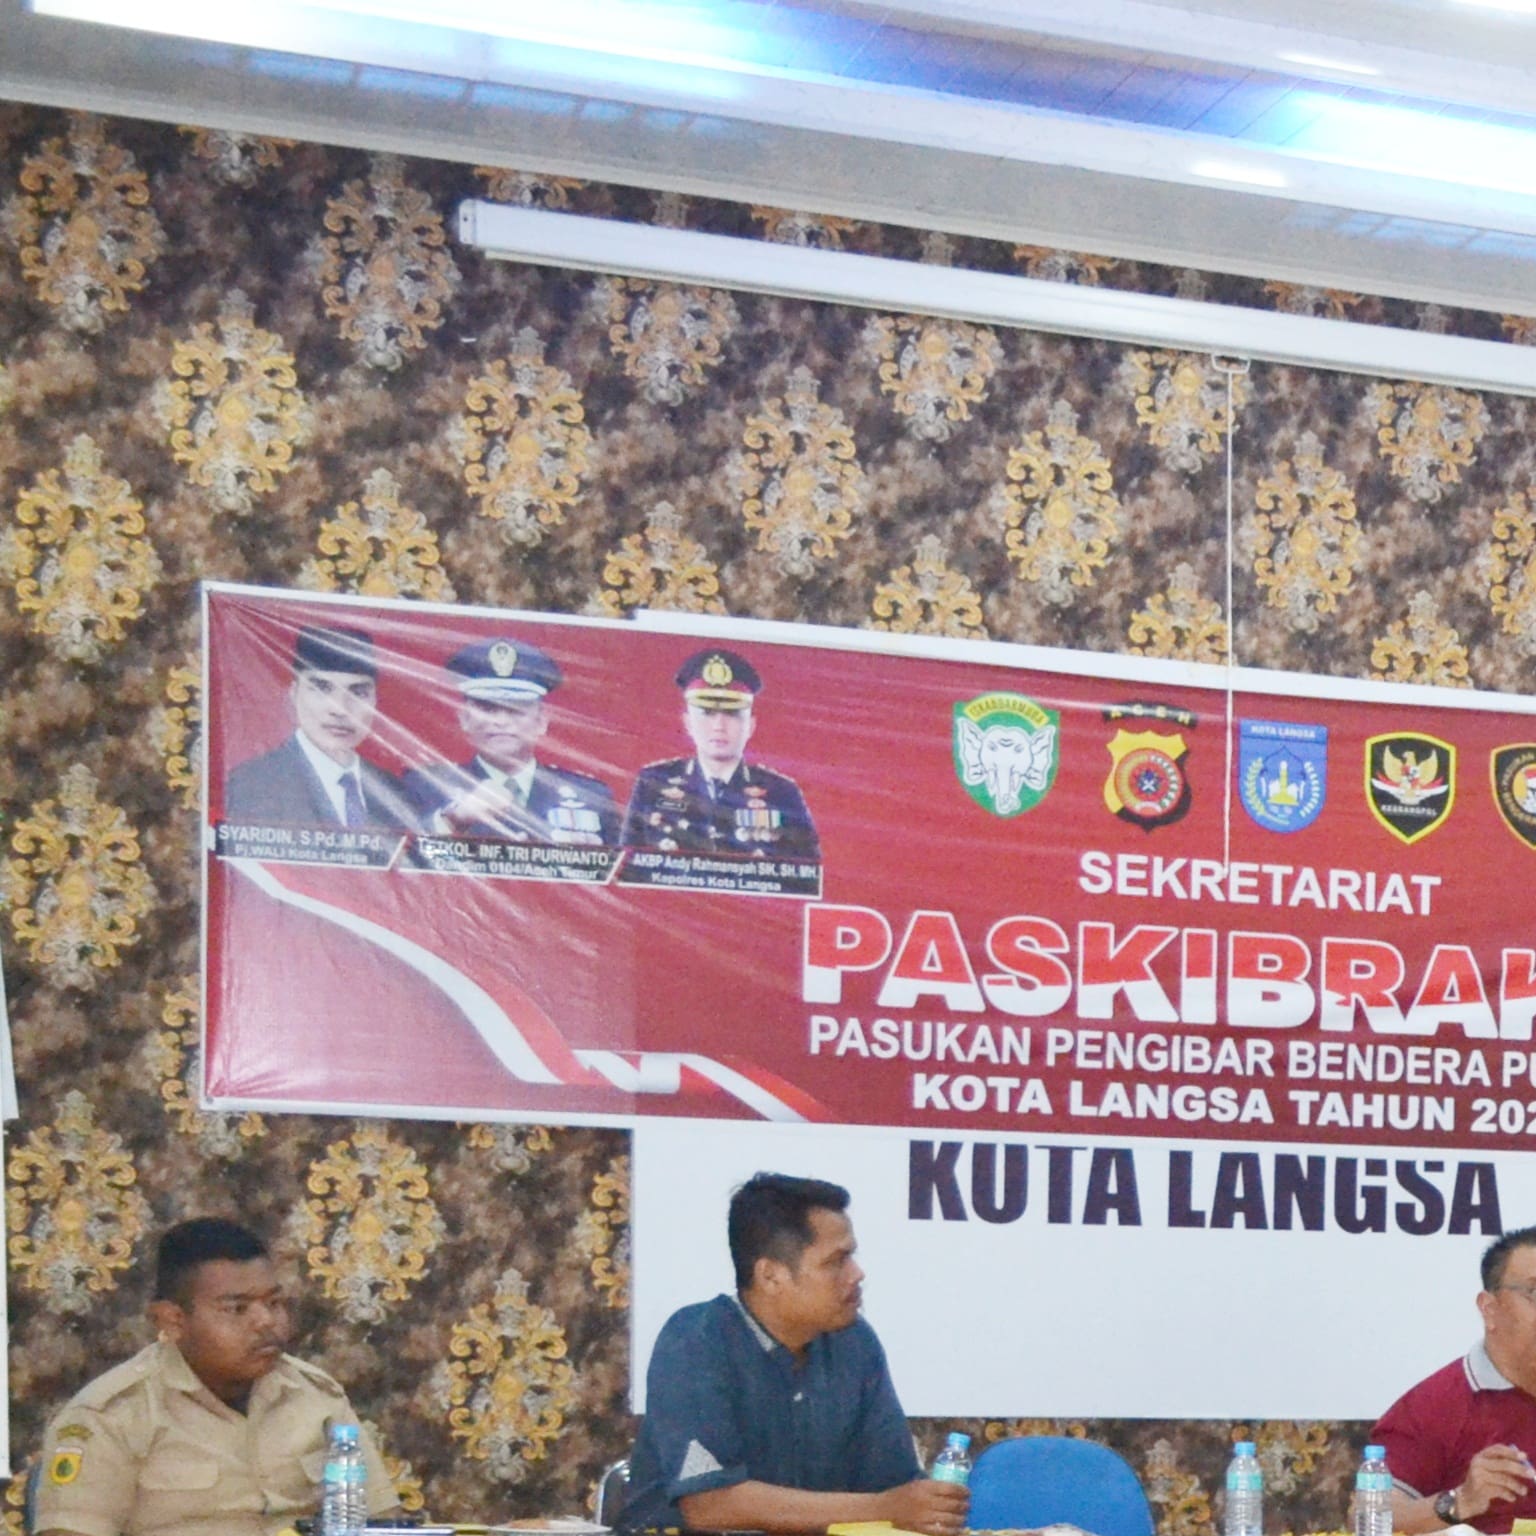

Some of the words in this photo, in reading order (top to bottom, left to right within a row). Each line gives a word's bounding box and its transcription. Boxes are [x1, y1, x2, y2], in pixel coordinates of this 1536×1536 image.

[508, 846, 529, 860] TRI
[633, 853, 663, 867] AKBP
[651, 872, 705, 887] Kapolres
[708, 876, 736, 889] Kota
[738, 877, 782, 893] Langsa
[1079, 851, 1441, 916] SEKRETARIAT
[809, 1014, 1031, 1065] PASUKAN
[1046, 1027, 1274, 1076] PENGIBAR
[1288, 1039, 1491, 1087] BENDERA
[912, 1072, 1053, 1115] KOTA
[1069, 1080, 1275, 1123] LANGSA
[1288, 1091, 1455, 1132] TAHUN
[1167, 1149, 1500, 1236] LANGSA
